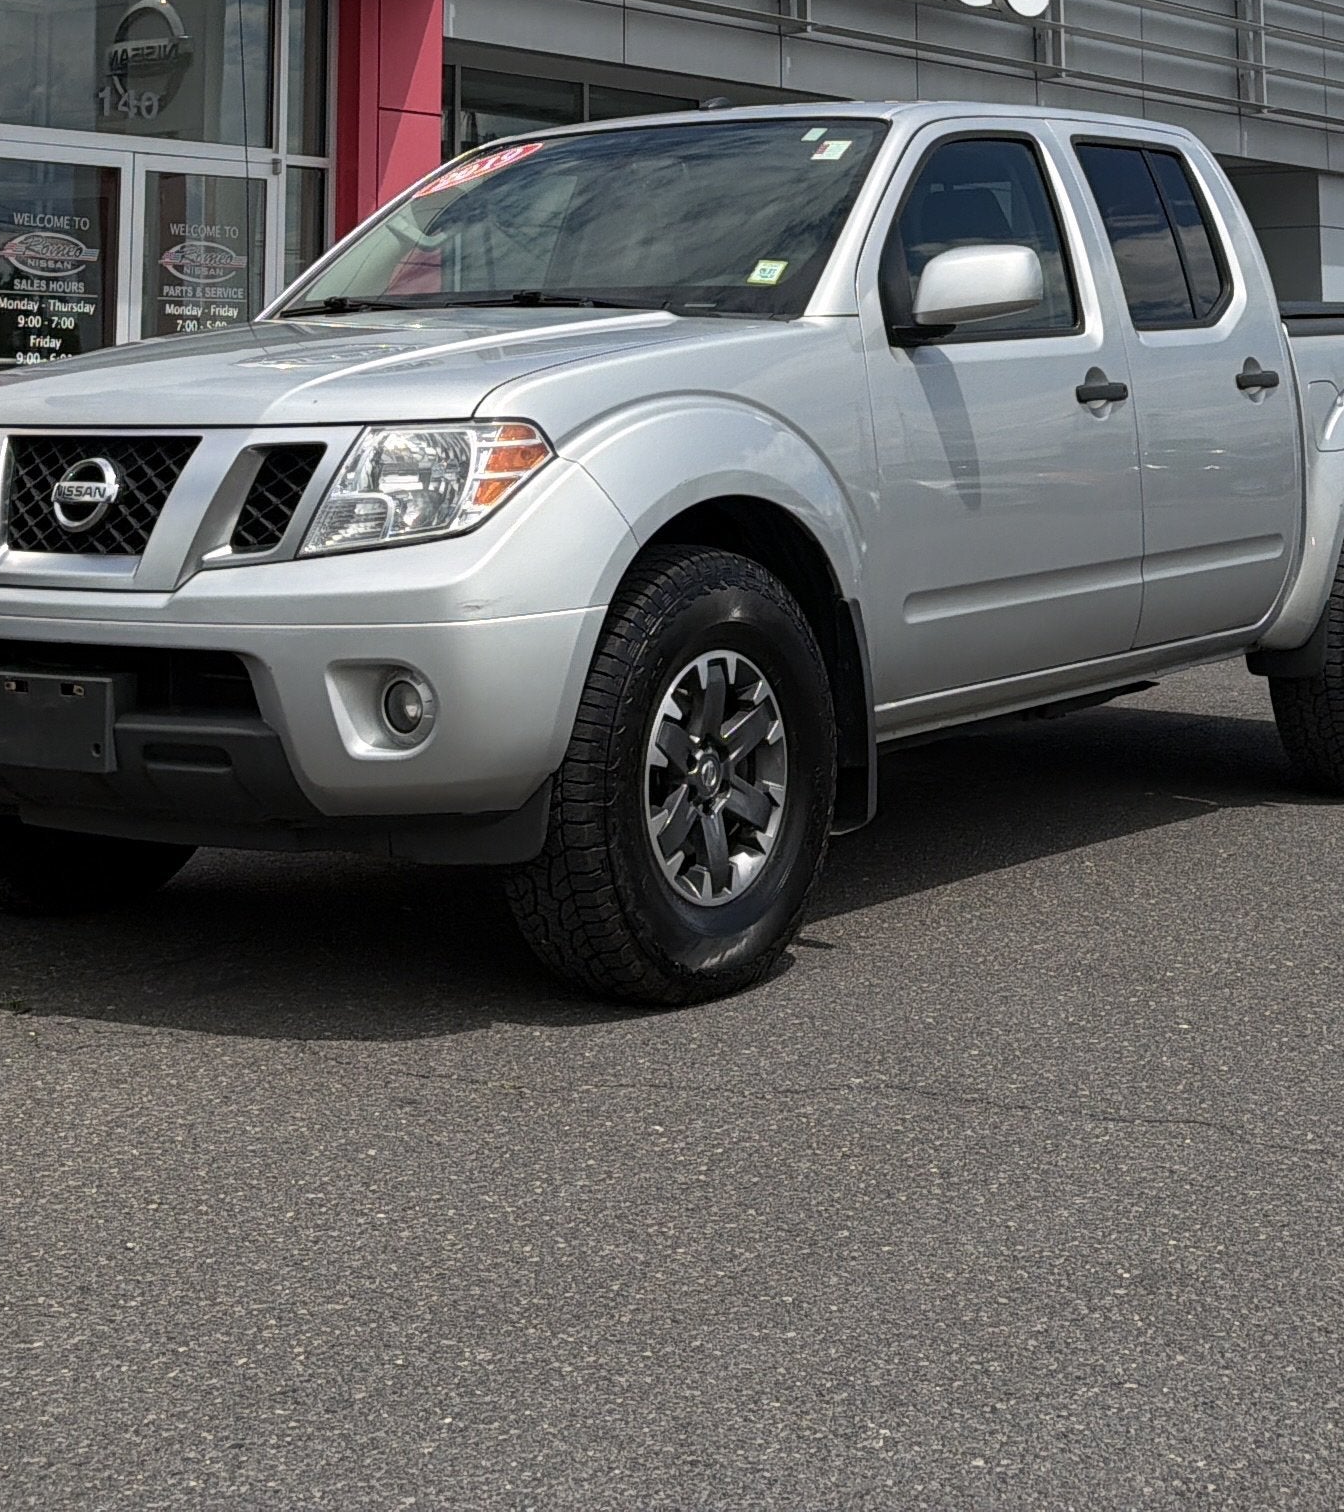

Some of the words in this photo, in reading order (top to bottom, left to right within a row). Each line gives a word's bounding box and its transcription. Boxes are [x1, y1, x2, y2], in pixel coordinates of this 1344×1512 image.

[98, 86, 159, 120] 140
[13, 212, 71, 229] WELCOME
[73, 216, 90, 231] TO
[170, 222, 221, 238] WELCOME
[224, 226, 239, 239] TO
[19, 234, 83, 259] Romeo
[27, 258, 72, 269] NISSAN
[183, 267, 224, 276] NISSAN
[13, 278, 47, 291] SALES
[49, 280, 85, 294] HOURS
[163, 285, 193, 297] PARTS
[196, 287, 203, 297] &
[204, 287, 244, 299] SERVICE
[48, 299, 96, 315] Thursday
[165, 303, 203, 317] Monday
[210, 304, 239, 318] Friday
[17, 315, 42, 328] 9:00
[51, 317, 75, 329] 7:00
[176, 320, 198, 332] 7:00
[29, 335, 63, 350] Friday
[16, 352, 41, 365] 9:00
[56, 484, 106, 499] NISSAN
